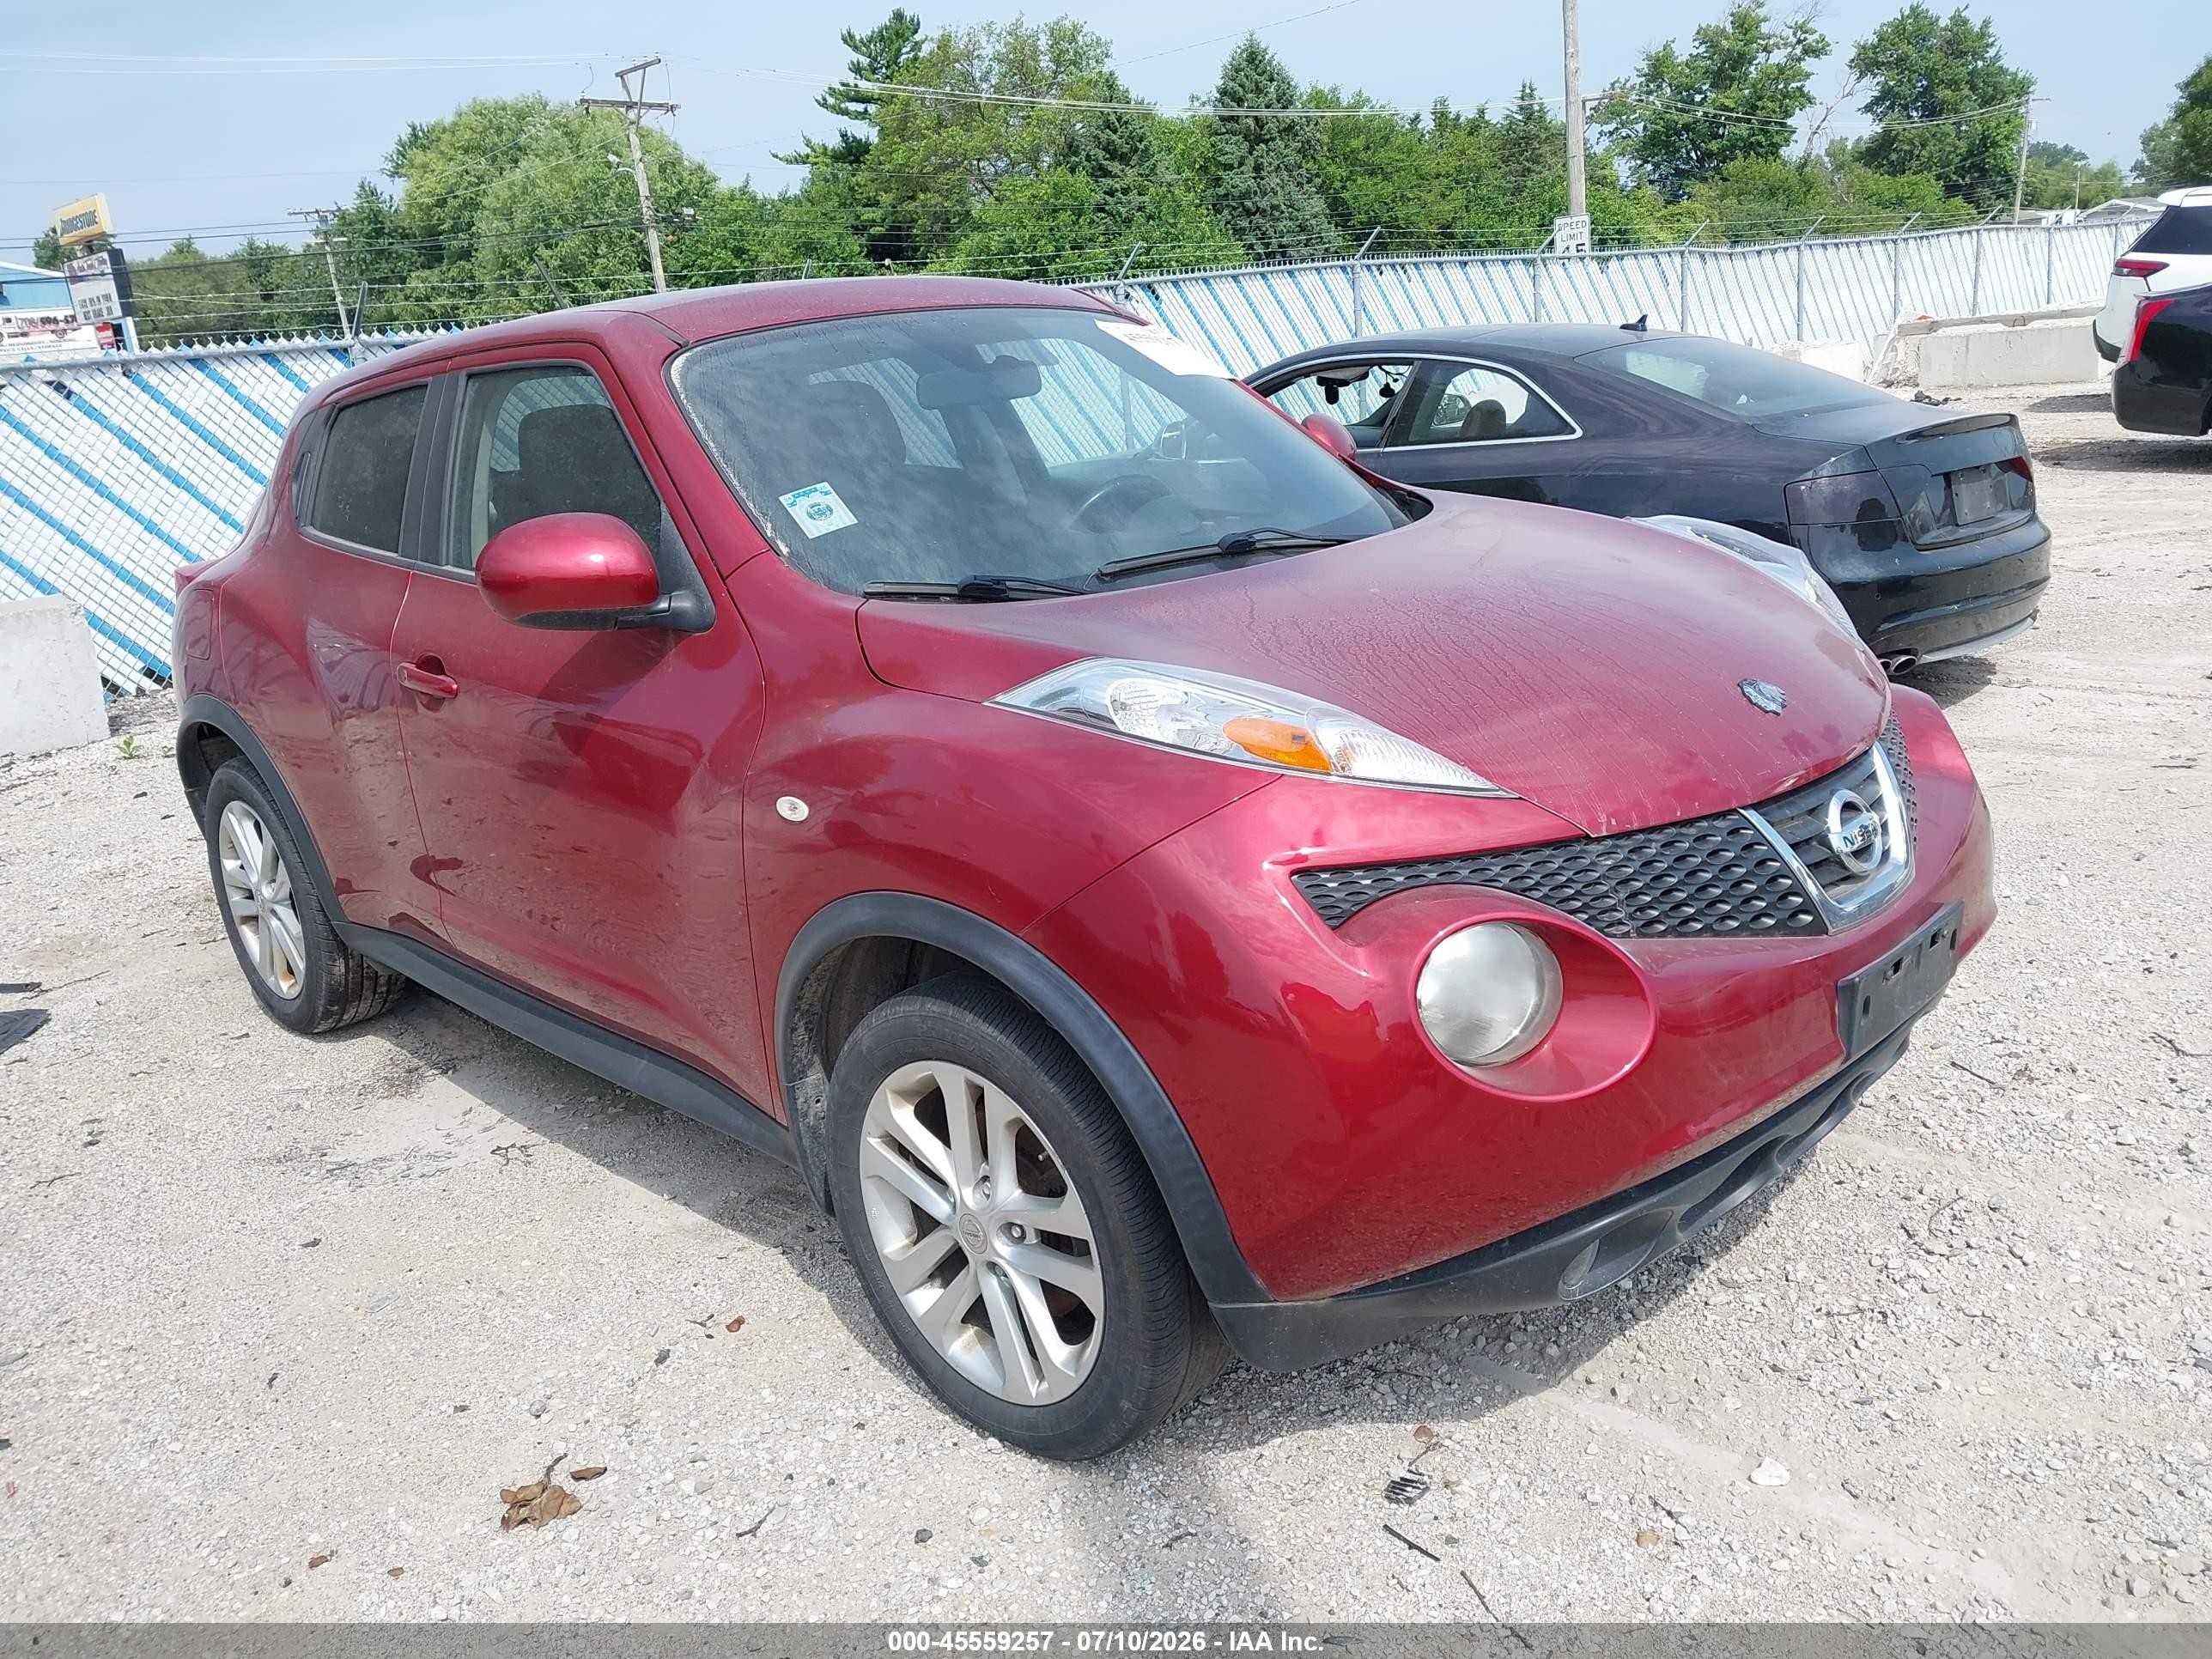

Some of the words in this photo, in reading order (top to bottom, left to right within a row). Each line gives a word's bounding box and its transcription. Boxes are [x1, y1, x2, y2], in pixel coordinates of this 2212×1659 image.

[60, 209, 98, 236] BRIDGESTONE
[1558, 220, 1587, 231] SPEED
[1560, 232, 1584, 242] LIMIT
